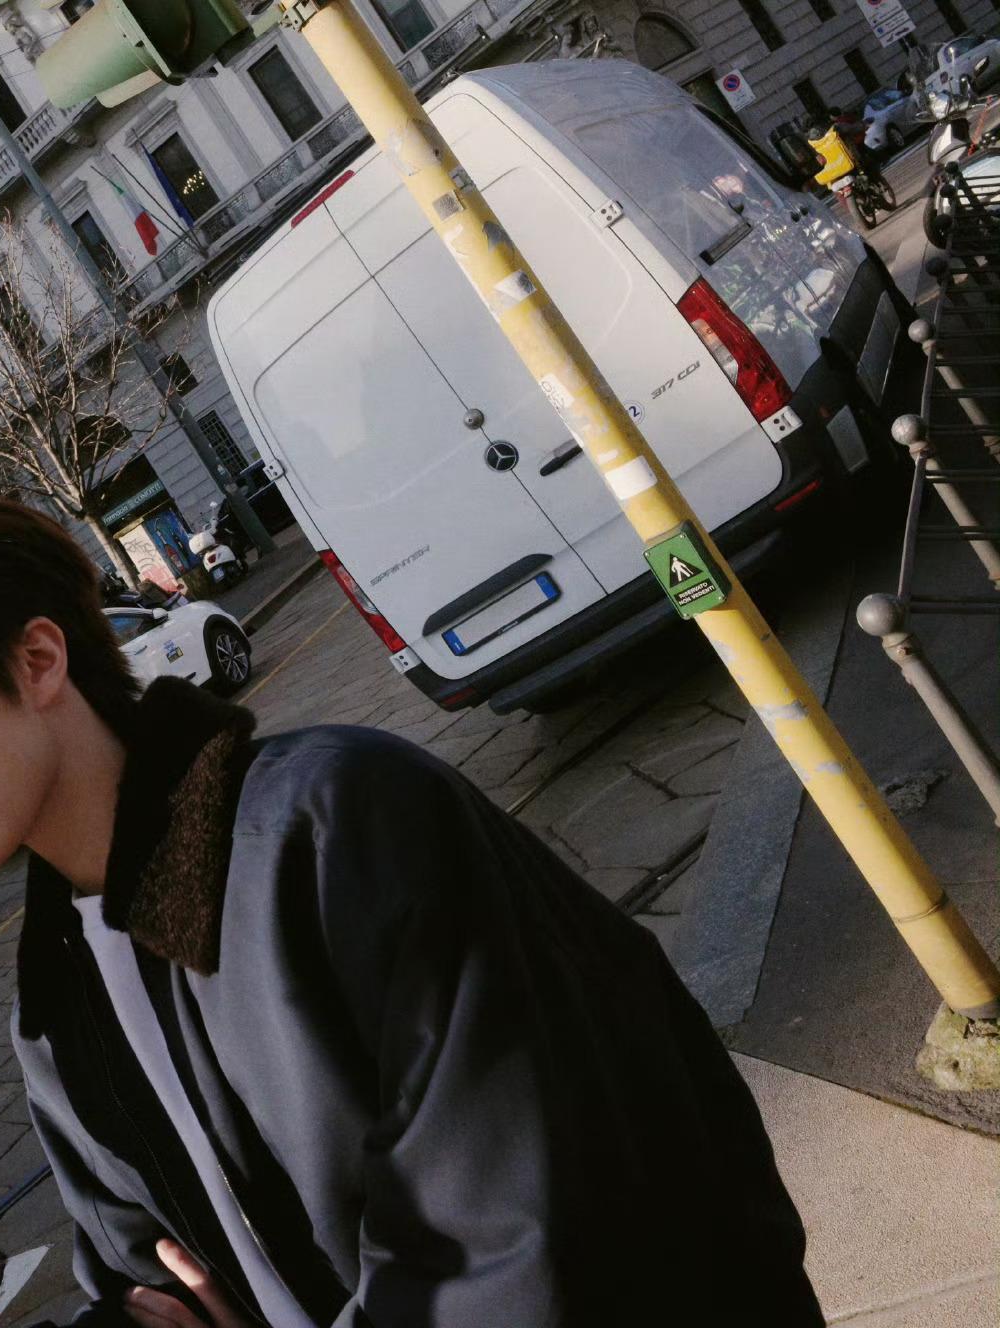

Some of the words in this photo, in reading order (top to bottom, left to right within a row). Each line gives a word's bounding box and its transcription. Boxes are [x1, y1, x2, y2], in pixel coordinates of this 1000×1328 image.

[650, 377, 675, 400] 317
[677, 360, 701, 381] CDI
[678, 582, 708, 599] RISERVATO
[679, 597, 692, 606] NON
[691, 585, 716, 600] VEDENTI
